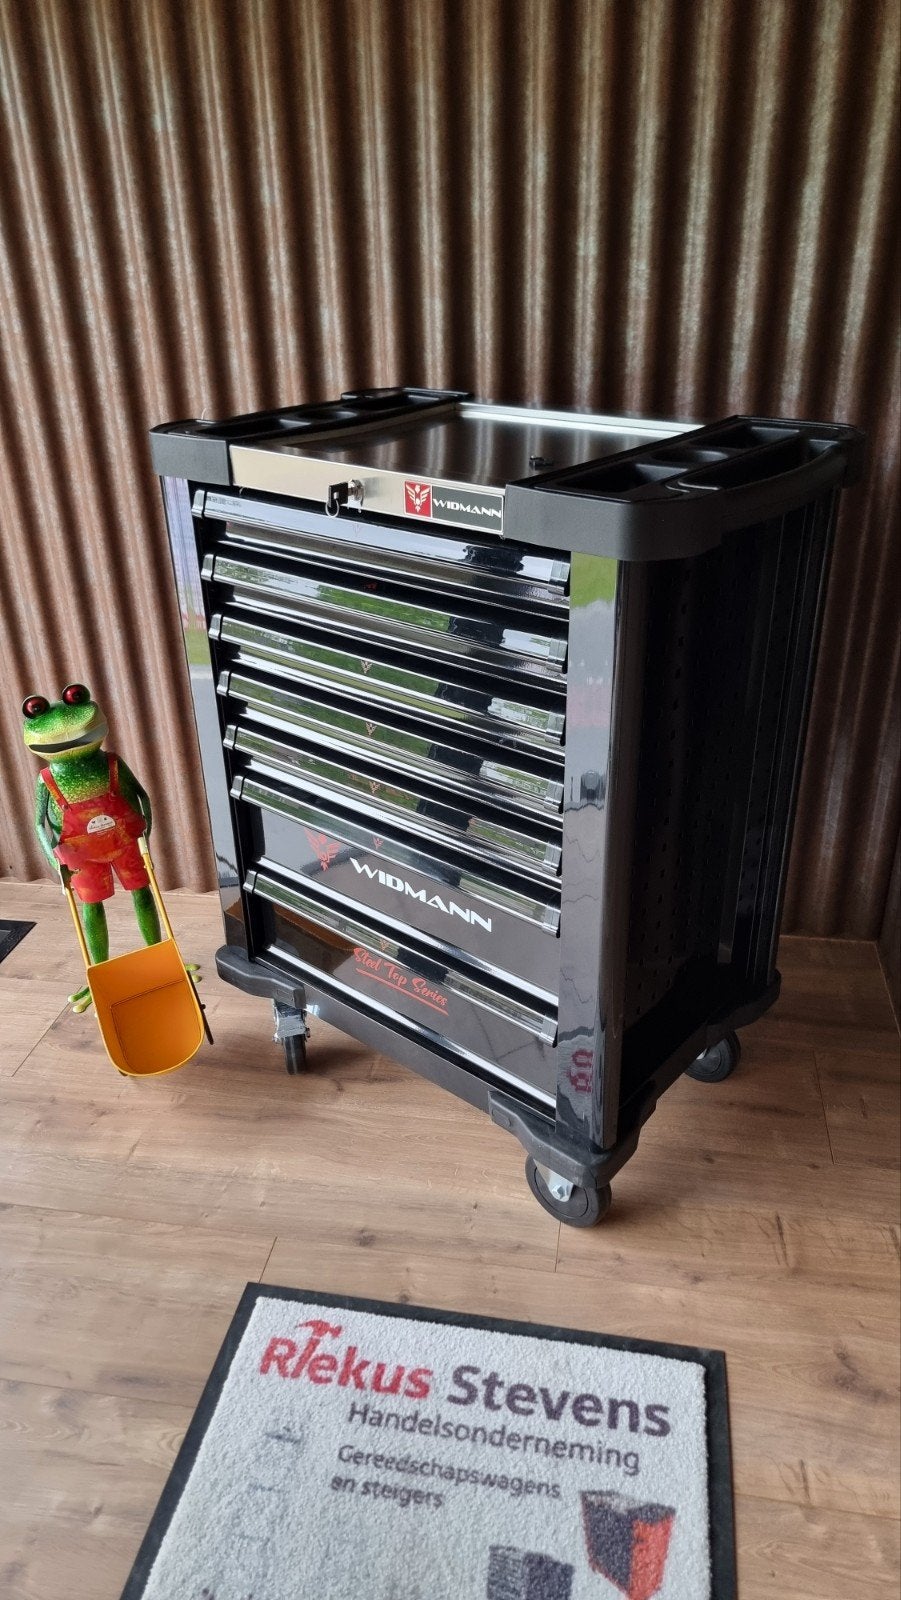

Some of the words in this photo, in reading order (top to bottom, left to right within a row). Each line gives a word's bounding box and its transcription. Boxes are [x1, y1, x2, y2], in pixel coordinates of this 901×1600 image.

[433, 498, 502, 519] WIDMANN
[350, 858, 492, 933] WIDMANN
[353, 947, 382, 971] Steel
[384, 962, 408, 988] Top
[411, 977, 448, 1006] Series
[259, 1320, 434, 1400] Riekus
[446, 1365, 673, 1438] Stevens
[347, 1401, 641, 1476] Handelsonderneming
[330, 1474, 357, 1493] en
[361, 1478, 444, 1509] steigers
[338, 1445, 561, 1500] Gereedschapswagens
